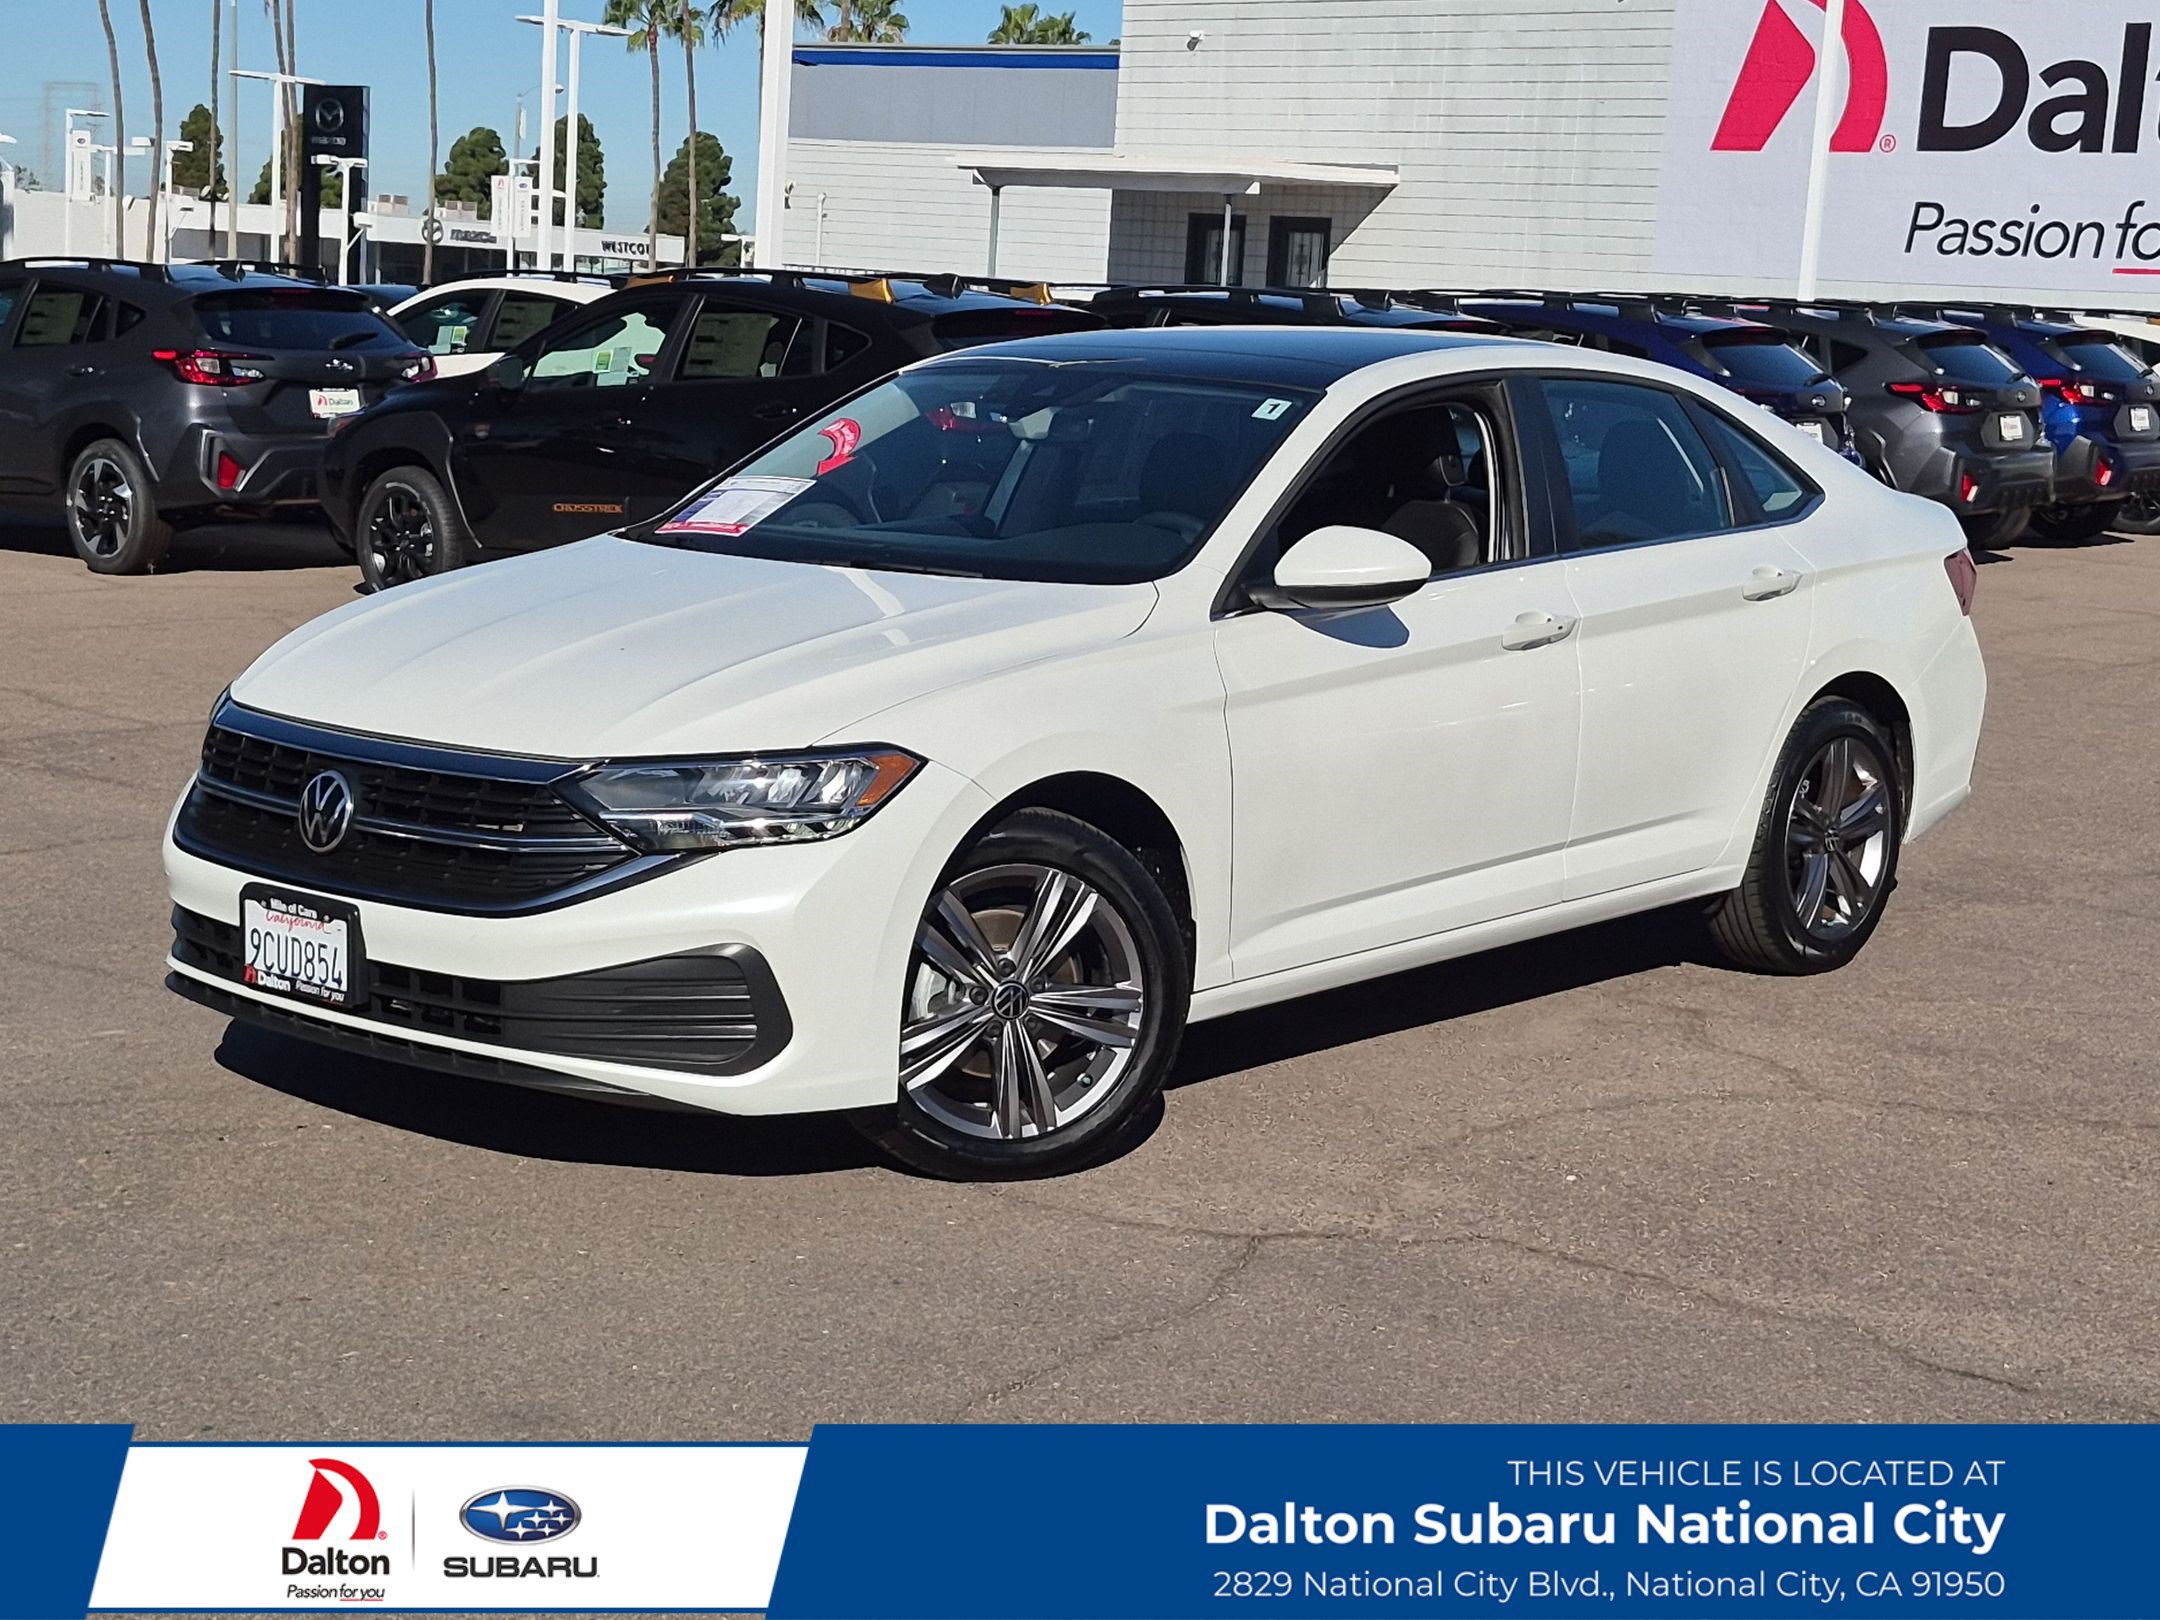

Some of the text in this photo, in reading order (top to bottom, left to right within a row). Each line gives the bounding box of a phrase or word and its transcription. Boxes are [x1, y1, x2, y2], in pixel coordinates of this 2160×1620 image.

[1917, 21, 2160, 154] Dal
[1904, 200, 2105, 259] Passion
[1268, 402, 1281, 415] 1
[250, 927, 343, 988] 9CUD854
[257, 970, 291, 992] Dalton
[331, 991, 345, 1002] you
